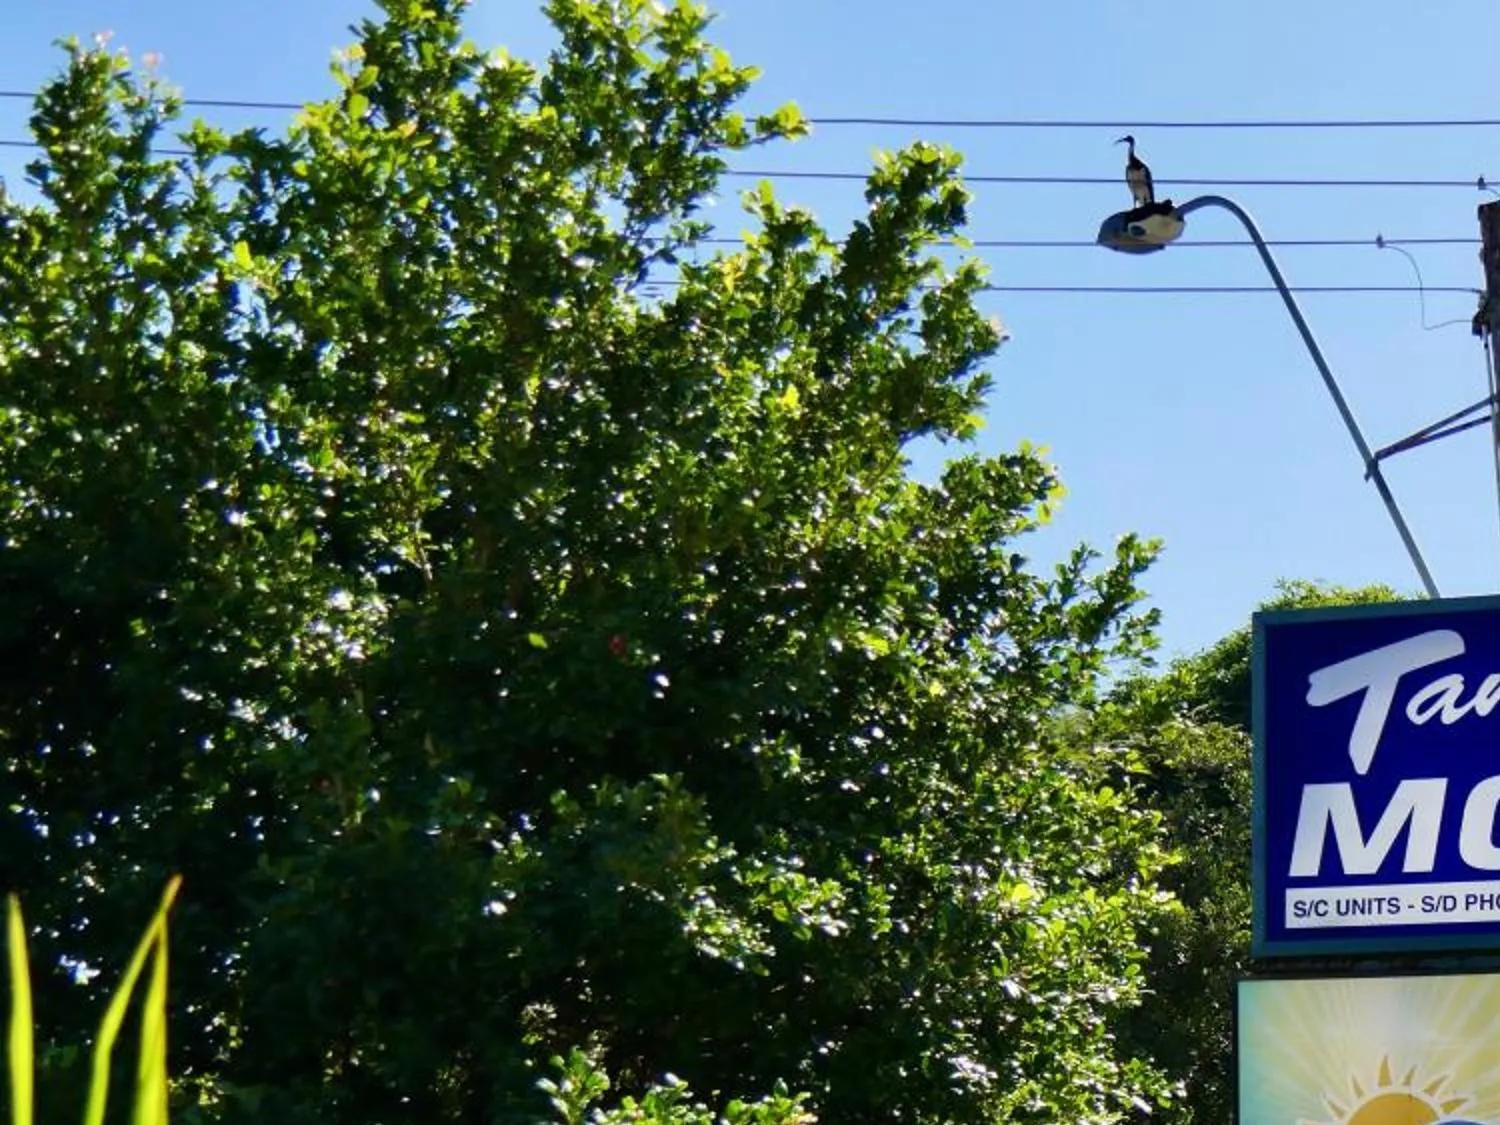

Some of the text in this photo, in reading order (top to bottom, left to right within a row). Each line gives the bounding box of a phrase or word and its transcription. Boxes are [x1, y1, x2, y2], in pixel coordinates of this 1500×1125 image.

[1293, 898, 1329, 919] S/C
[1335, 896, 1401, 917] UNITS
[1421, 895, 1458, 914] S/D
